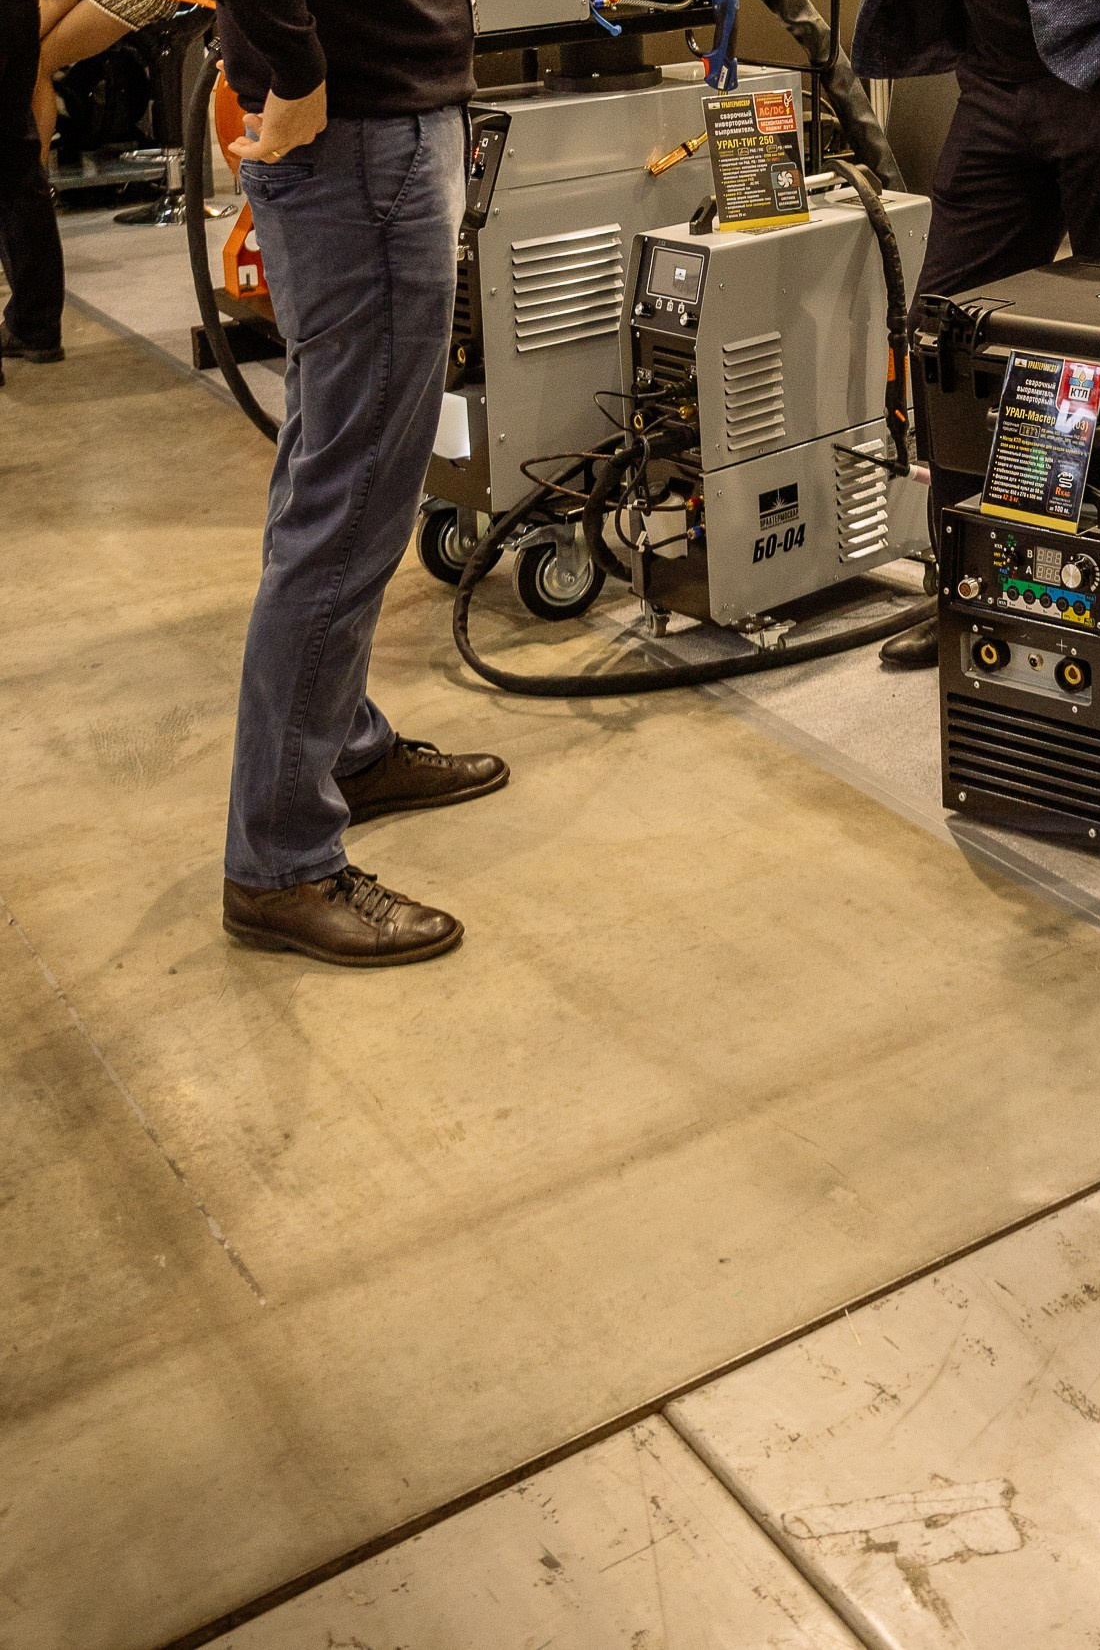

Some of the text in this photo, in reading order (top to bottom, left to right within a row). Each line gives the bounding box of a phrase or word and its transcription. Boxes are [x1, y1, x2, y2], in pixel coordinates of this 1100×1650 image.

[720, 111, 752, 120] сварочный
[717, 135, 774, 150] УРАЛ-ТИГ 250
[1071, 388, 1088, 399] КТЛ
[1005, 406, 1056, 426] УРАЛ-Мастер
[753, 523, 805, 564] БО-04
